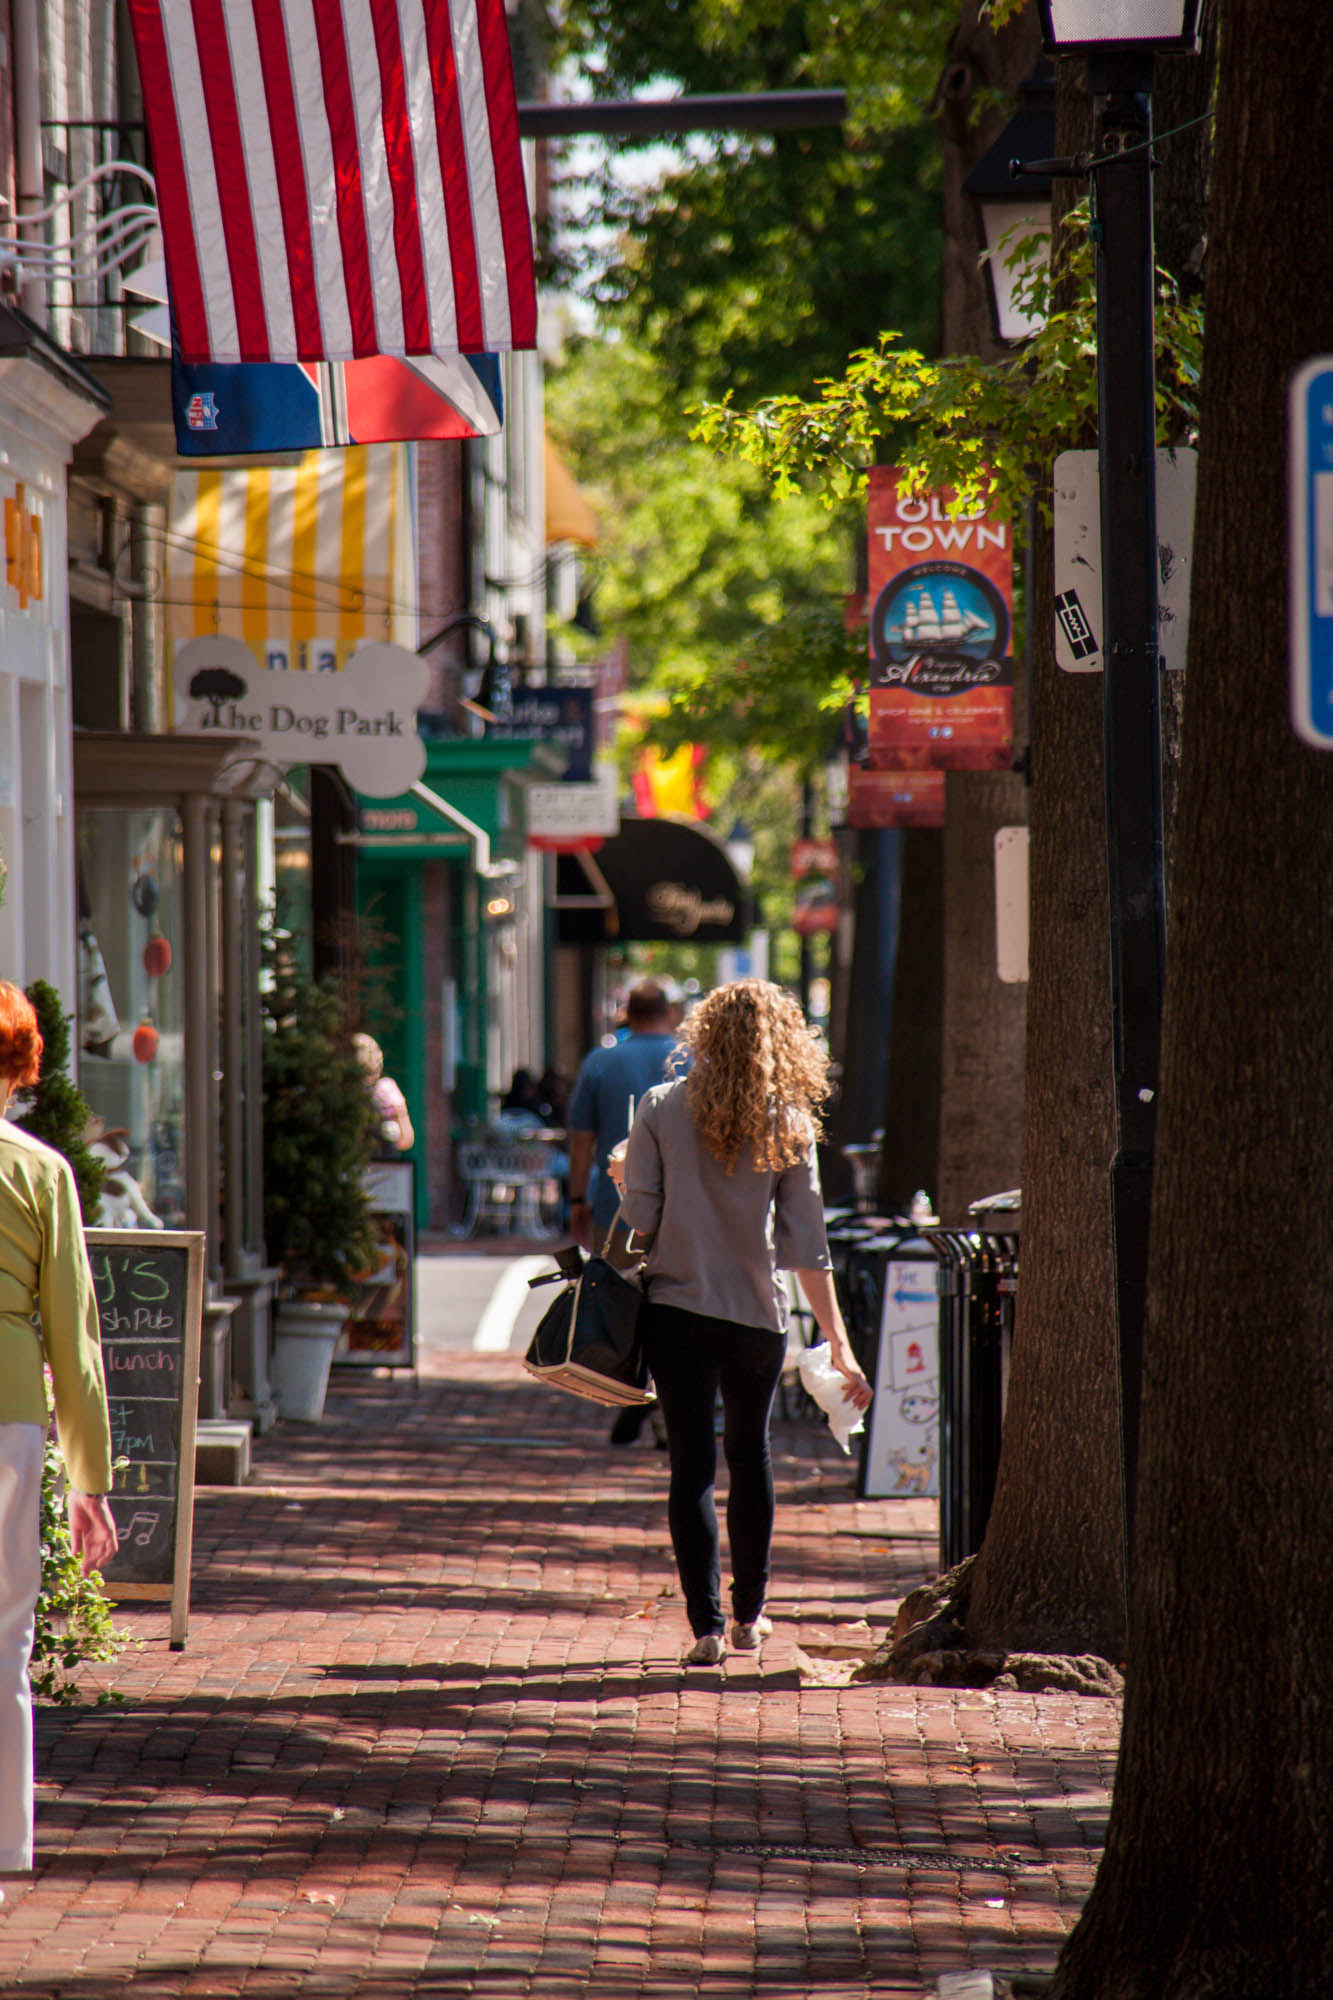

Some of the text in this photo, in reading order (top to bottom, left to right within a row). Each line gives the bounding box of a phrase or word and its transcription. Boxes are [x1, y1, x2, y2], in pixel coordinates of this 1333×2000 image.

[874, 525, 1006, 552] TOWN
[203, 703, 403, 739] The Dog Park
[134, 1307, 174, 1331] Pub
[108, 1346, 174, 1372] lunch
